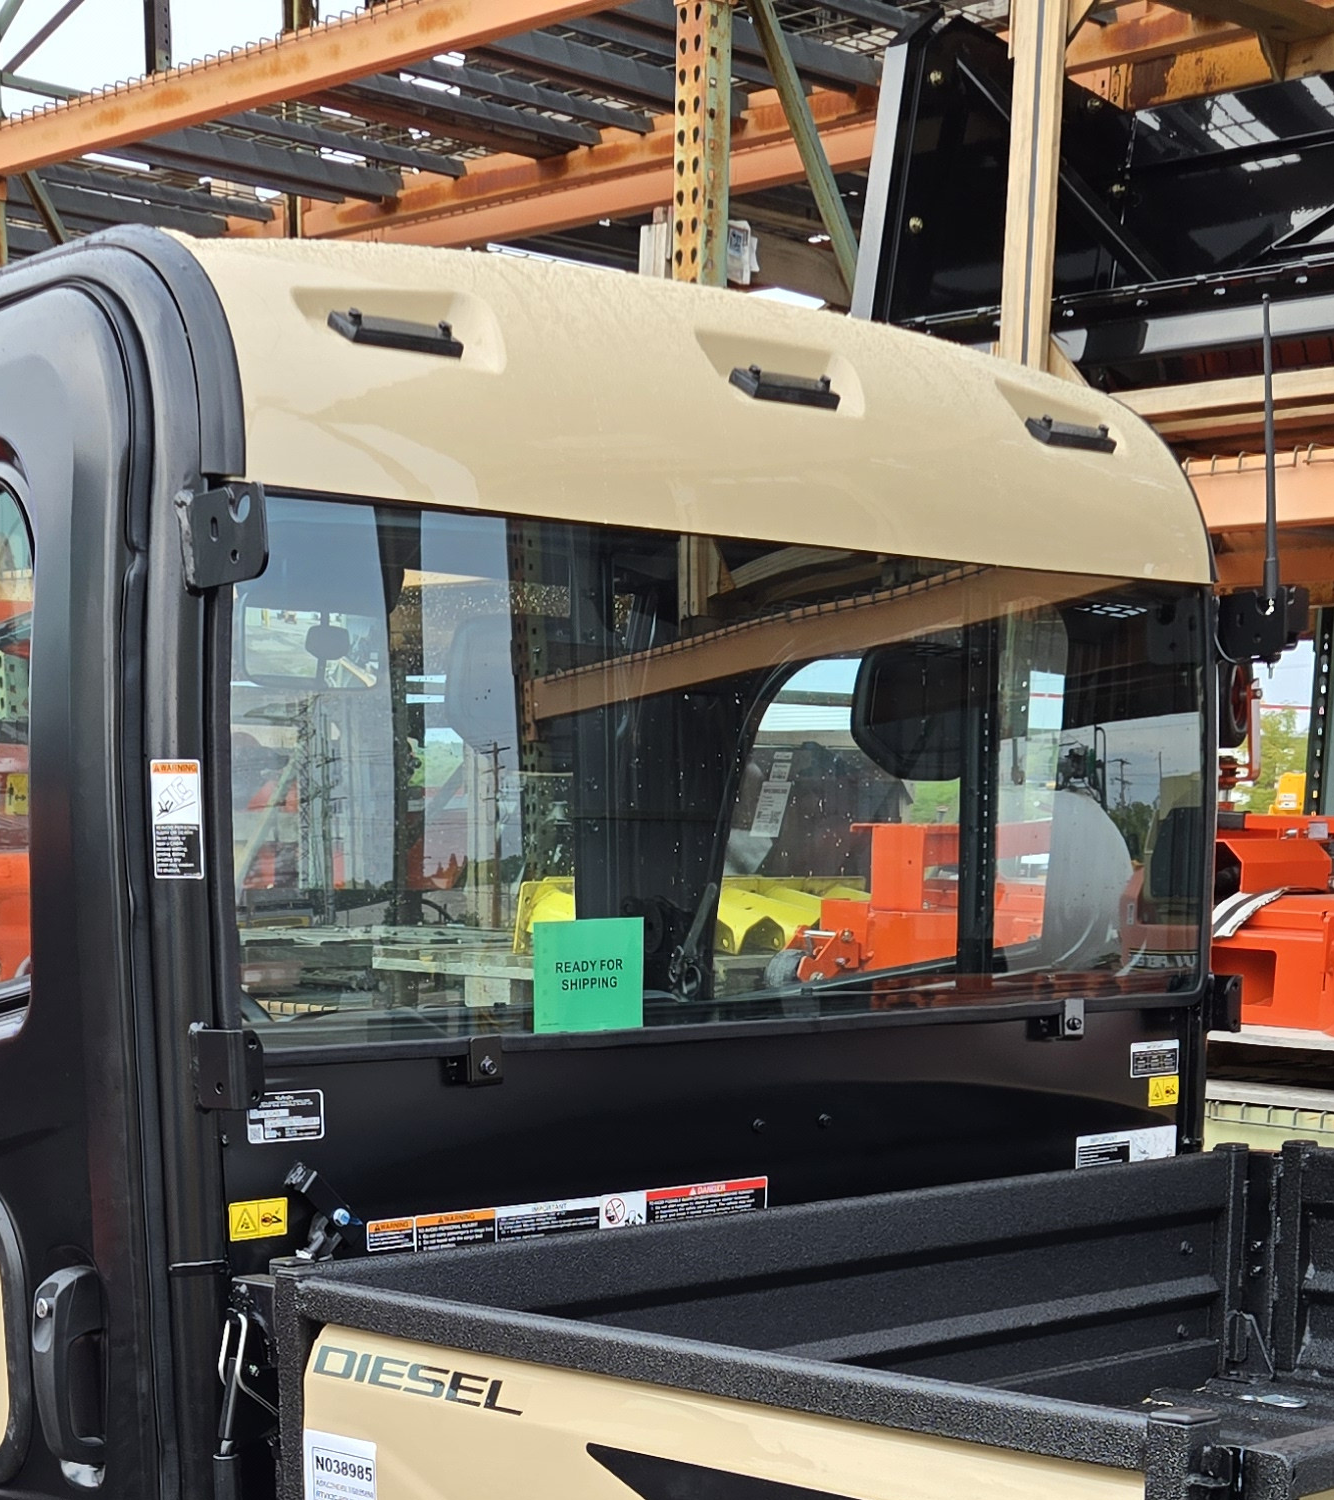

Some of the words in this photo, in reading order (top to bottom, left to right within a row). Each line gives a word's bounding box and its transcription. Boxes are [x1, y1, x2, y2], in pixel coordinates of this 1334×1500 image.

[160, 763, 197, 773] WARNING
[555, 960, 597, 974] READY
[600, 958, 623, 971] FOR
[561, 976, 618, 991] SHIPPING
[697, 1184, 726, 1195] DANGER
[313, 1344, 523, 1417] DIESEL
[315, 1455, 373, 1482] N038985
